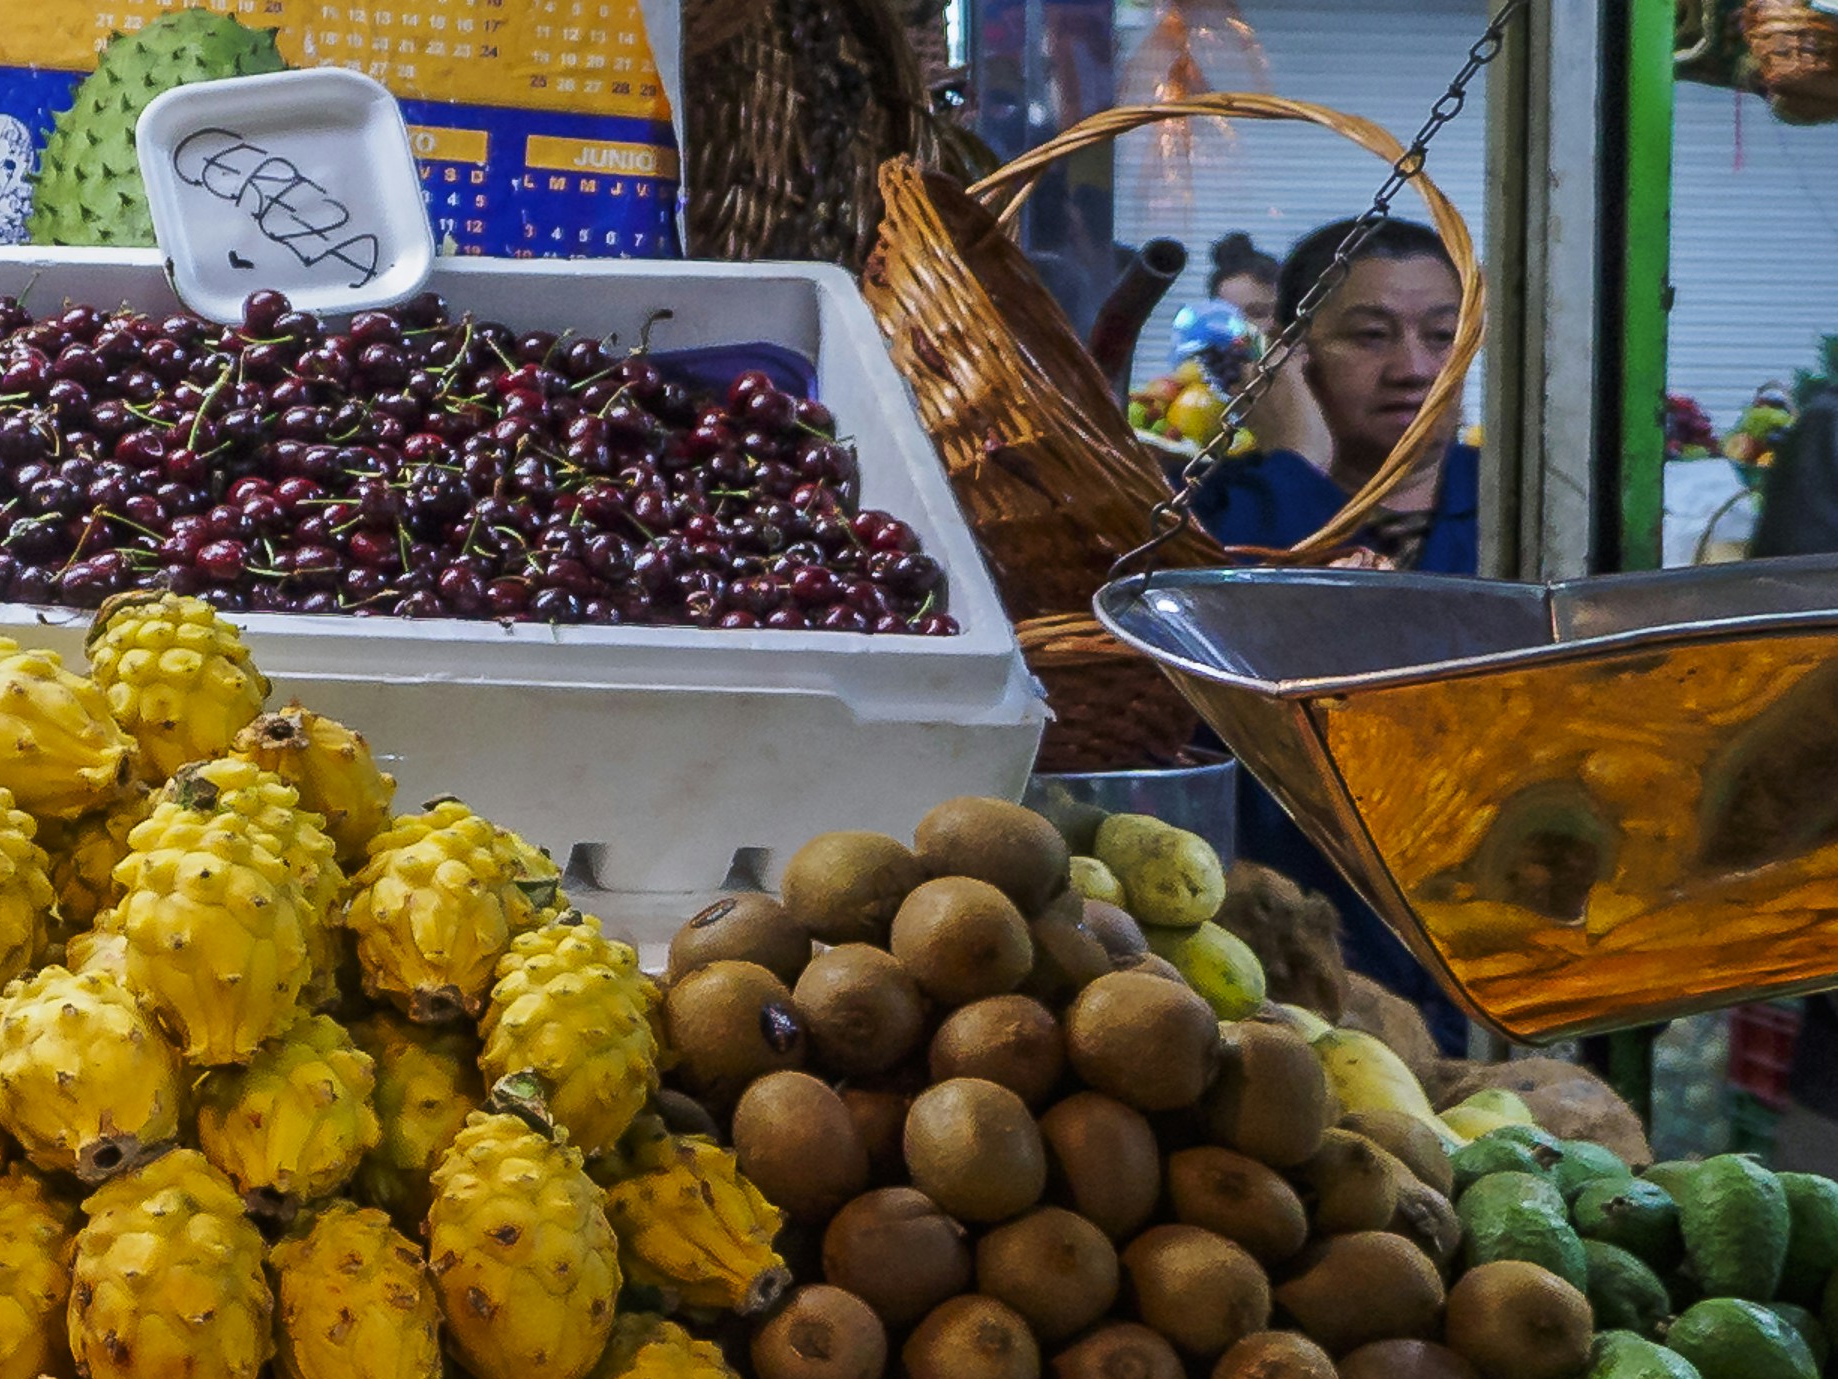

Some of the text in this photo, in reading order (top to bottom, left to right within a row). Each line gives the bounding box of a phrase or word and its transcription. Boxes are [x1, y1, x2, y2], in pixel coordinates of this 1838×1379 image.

[484, 19, 502, 32] 17
[563, 27, 580, 41] 12
[573, 147, 657, 172] JUNIO
[523, 175, 535, 189] L
[549, 176, 567, 191] M
[580, 179, 597, 193] M
[610, 182, 623, 196] J
[447, 192, 458, 206] 4
[175, 127, 379, 289] CEREZA
[466, 220, 484, 233] 12
[551, 226, 563, 240] 4
[635, 233, 644, 247] 7
